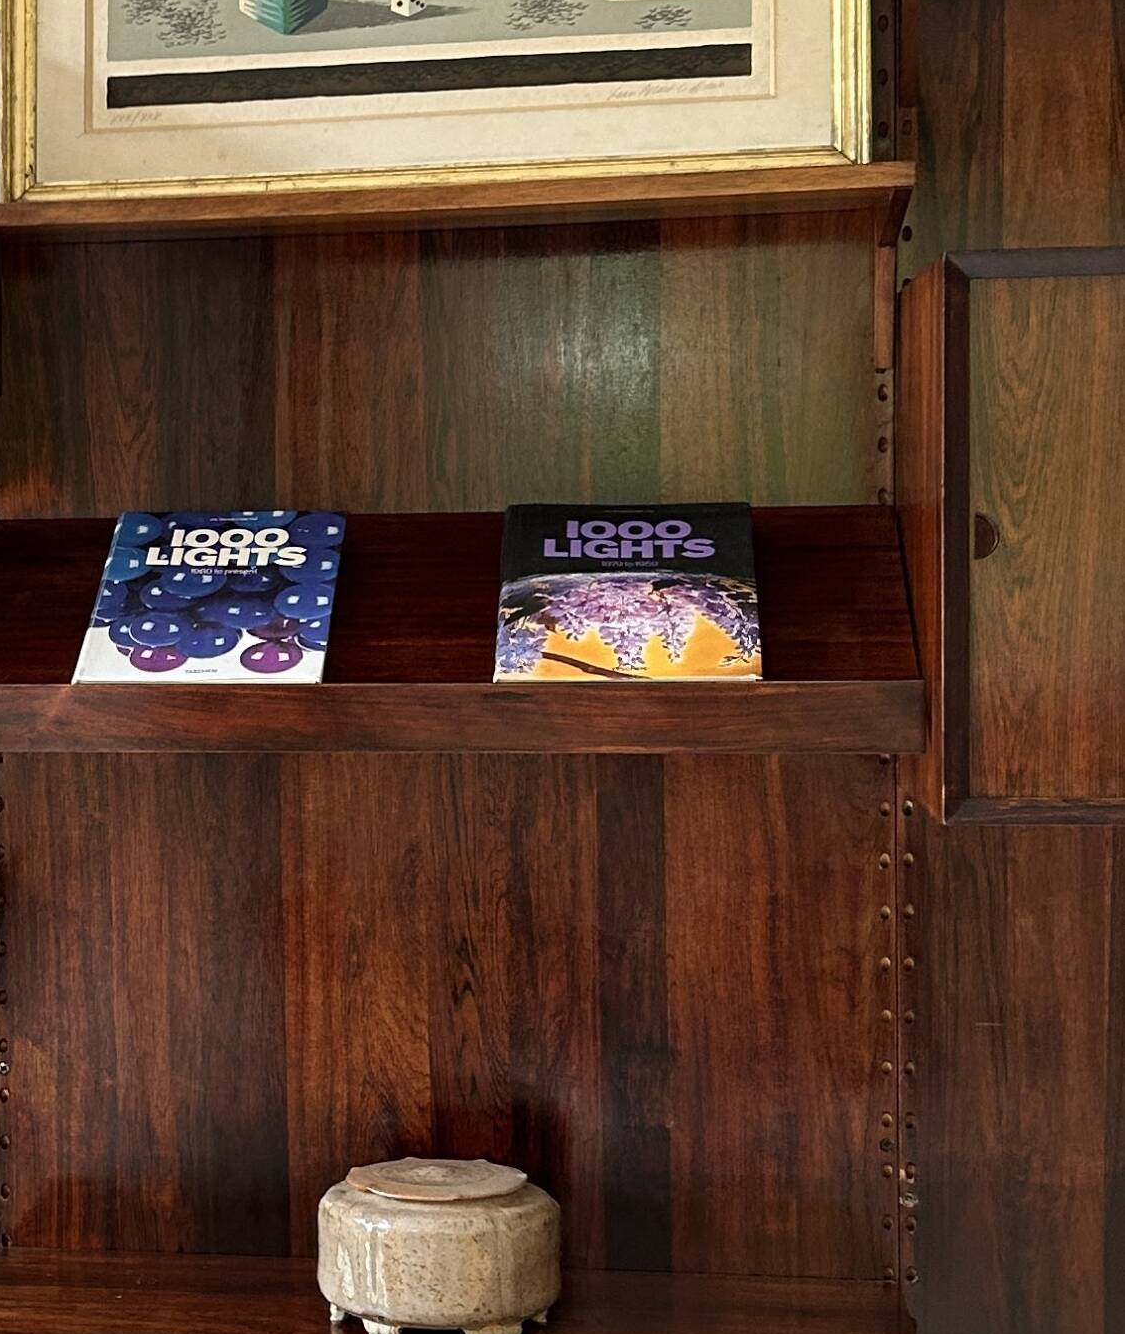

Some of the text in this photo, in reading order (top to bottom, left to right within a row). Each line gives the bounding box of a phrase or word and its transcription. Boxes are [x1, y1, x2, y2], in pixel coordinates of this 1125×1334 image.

[170, 528, 290, 548] 1000
[566, 520, 692, 539] 1000
[145, 547, 307, 566] LIGHTS
[543, 538, 716, 558] LIGHTS
